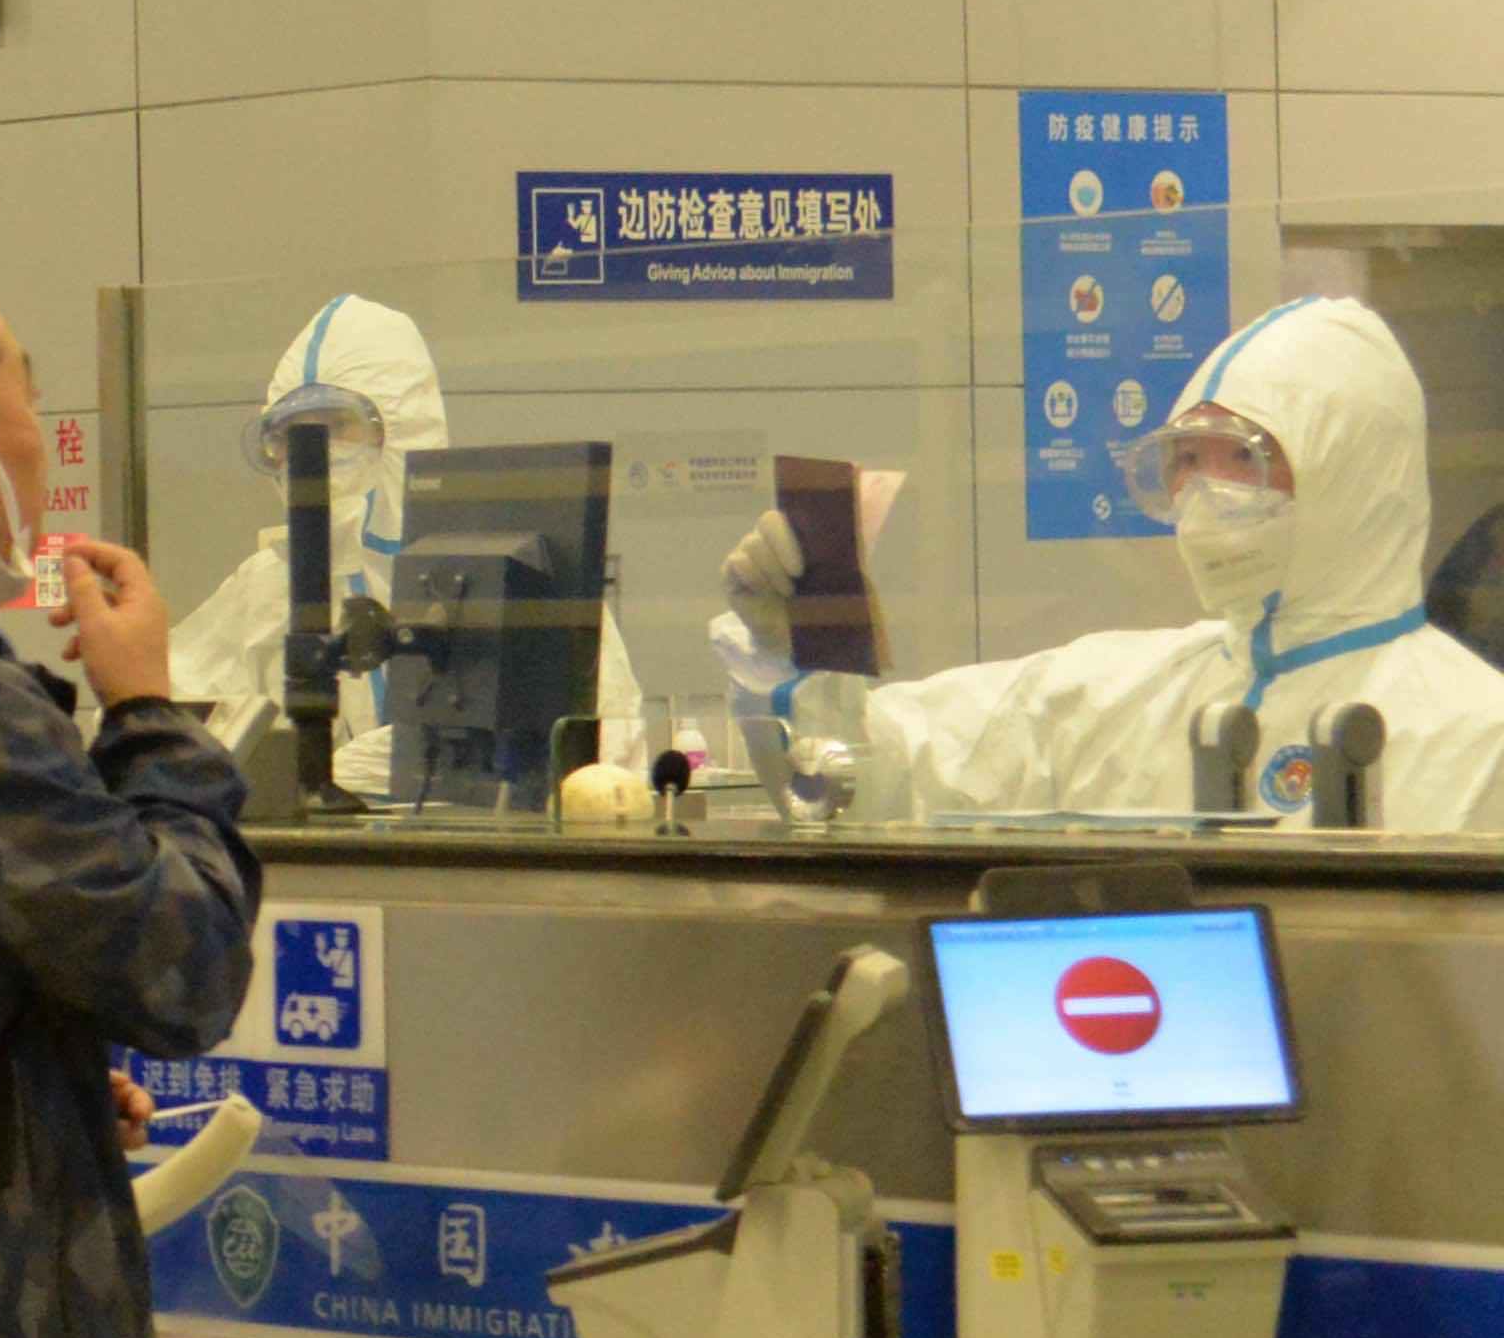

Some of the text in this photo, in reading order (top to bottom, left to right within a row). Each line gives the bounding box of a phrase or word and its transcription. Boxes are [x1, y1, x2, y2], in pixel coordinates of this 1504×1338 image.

[1048, 113, 1201, 143] 防疫健康提示
[618, 189, 882, 241] 边防检查意见填写处
[647, 264, 855, 284] Giving Advice about Immigration
[265, 1067, 376, 1113] 紧急求助
[313, 1291, 400, 1328] CHINA
